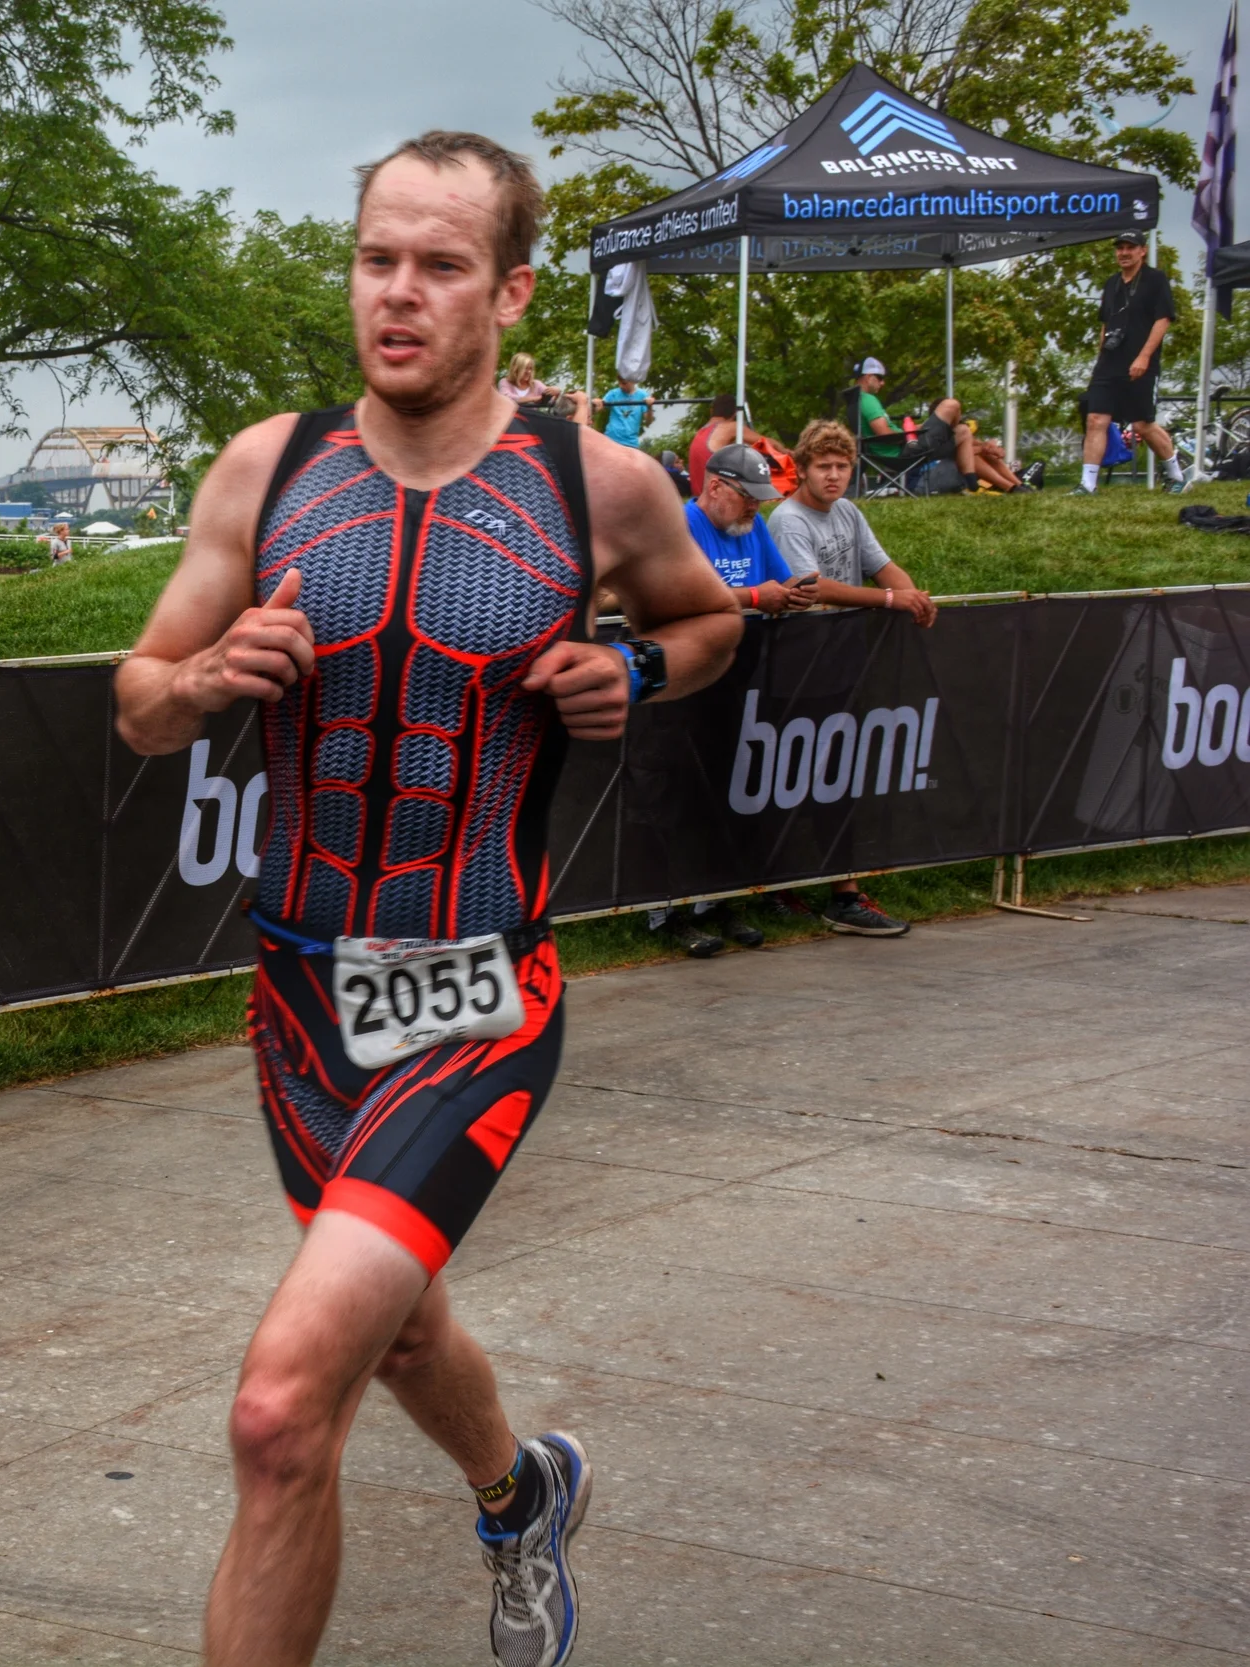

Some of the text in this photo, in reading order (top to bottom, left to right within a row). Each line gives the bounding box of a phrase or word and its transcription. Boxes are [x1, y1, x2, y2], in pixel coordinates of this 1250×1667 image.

[821, 149, 1018, 174] BALANCED ART
[871, 164, 989, 177] MULTISPORT
[593, 193, 738, 258] endurance athletes united
[783, 189, 1120, 221] balancedartmultisport.com
[728, 689, 939, 815] boom!
[345, 948, 502, 1036] 2055
